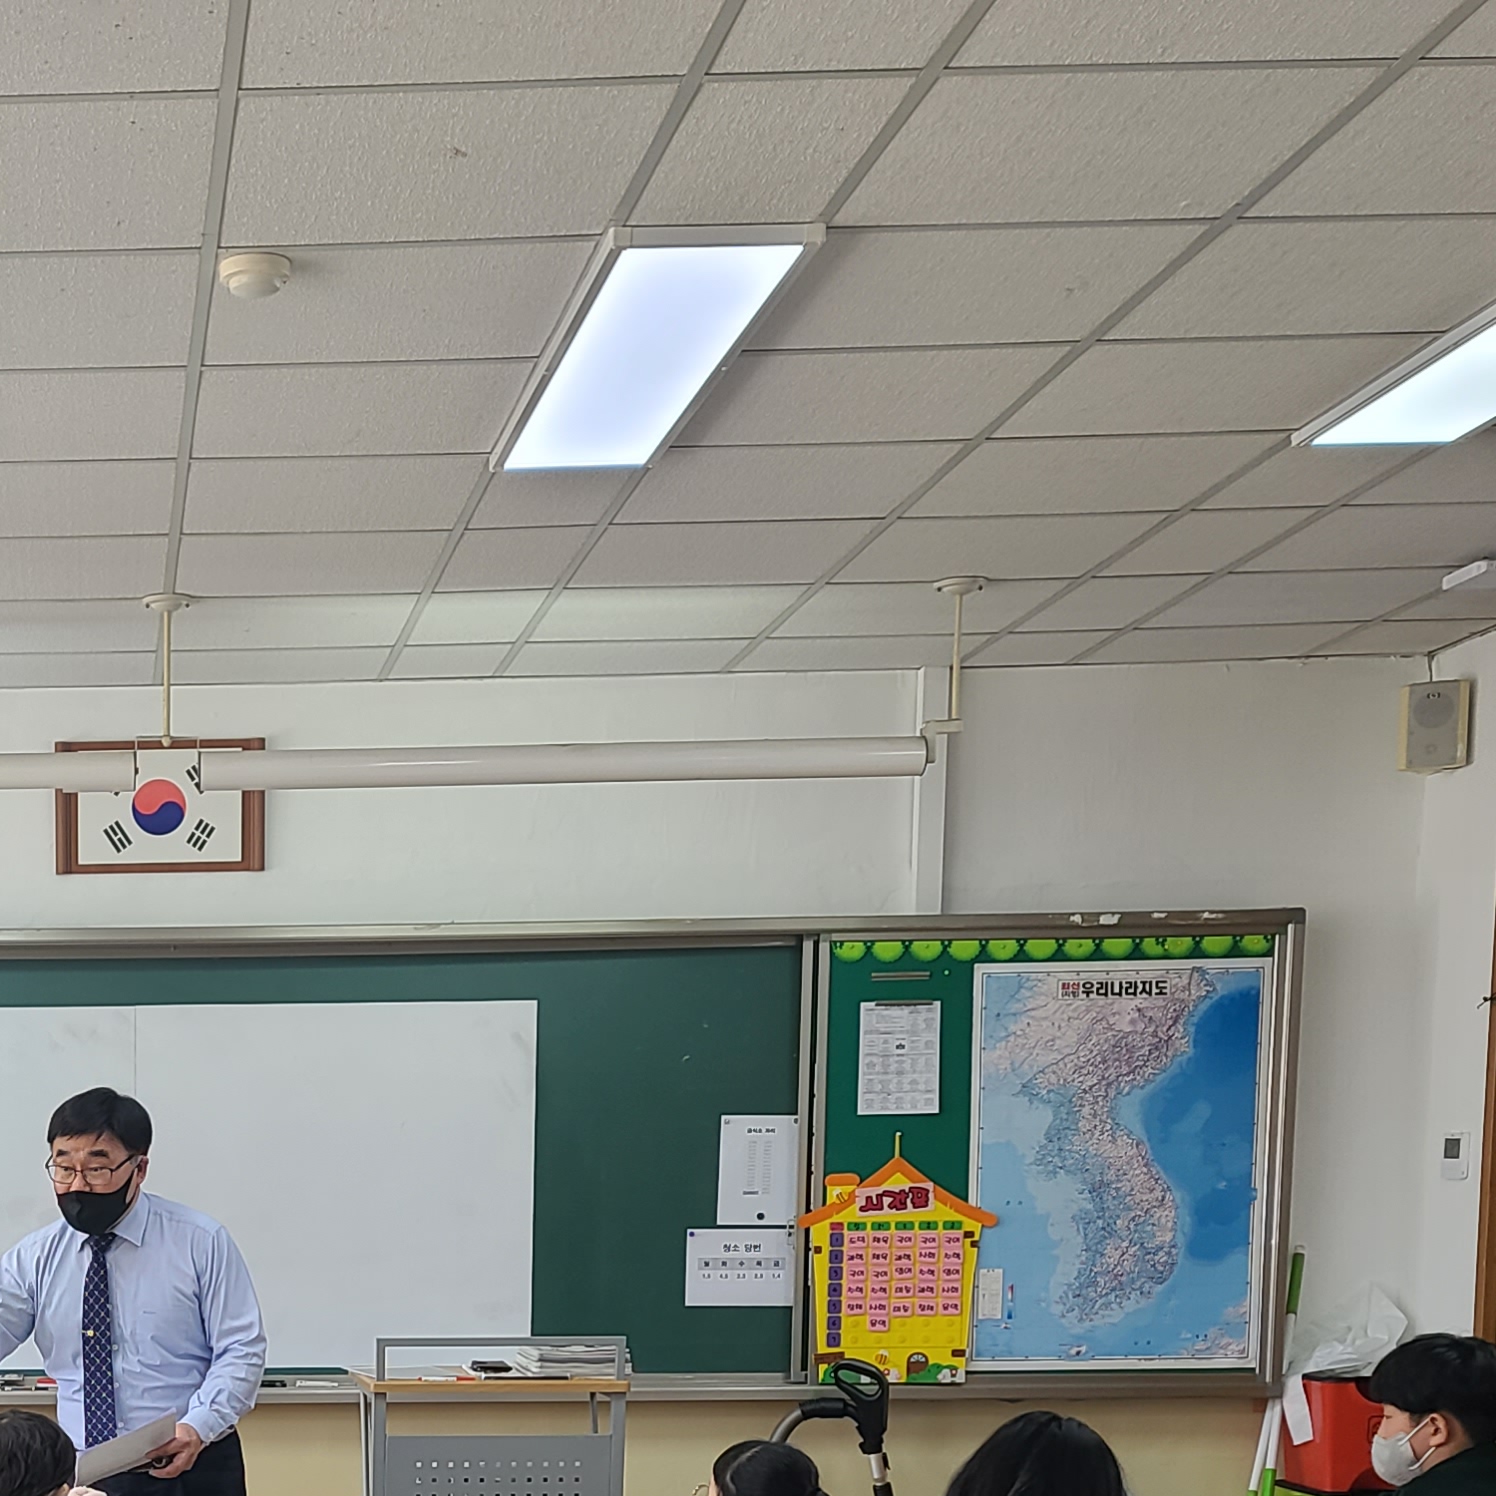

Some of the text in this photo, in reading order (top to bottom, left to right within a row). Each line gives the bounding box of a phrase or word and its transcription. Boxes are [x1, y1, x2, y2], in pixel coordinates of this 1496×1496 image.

[1081, 980, 1168, 998] 우리나라지도
[859, 1186, 930, 1213] 시간표
[897, 1235, 912, 1244] 국어
[920, 1236, 936, 1245] 국어
[944, 1236, 960, 1245] 국어
[849, 1269, 865, 1278] 국어
[872, 1270, 889, 1279] 국어
